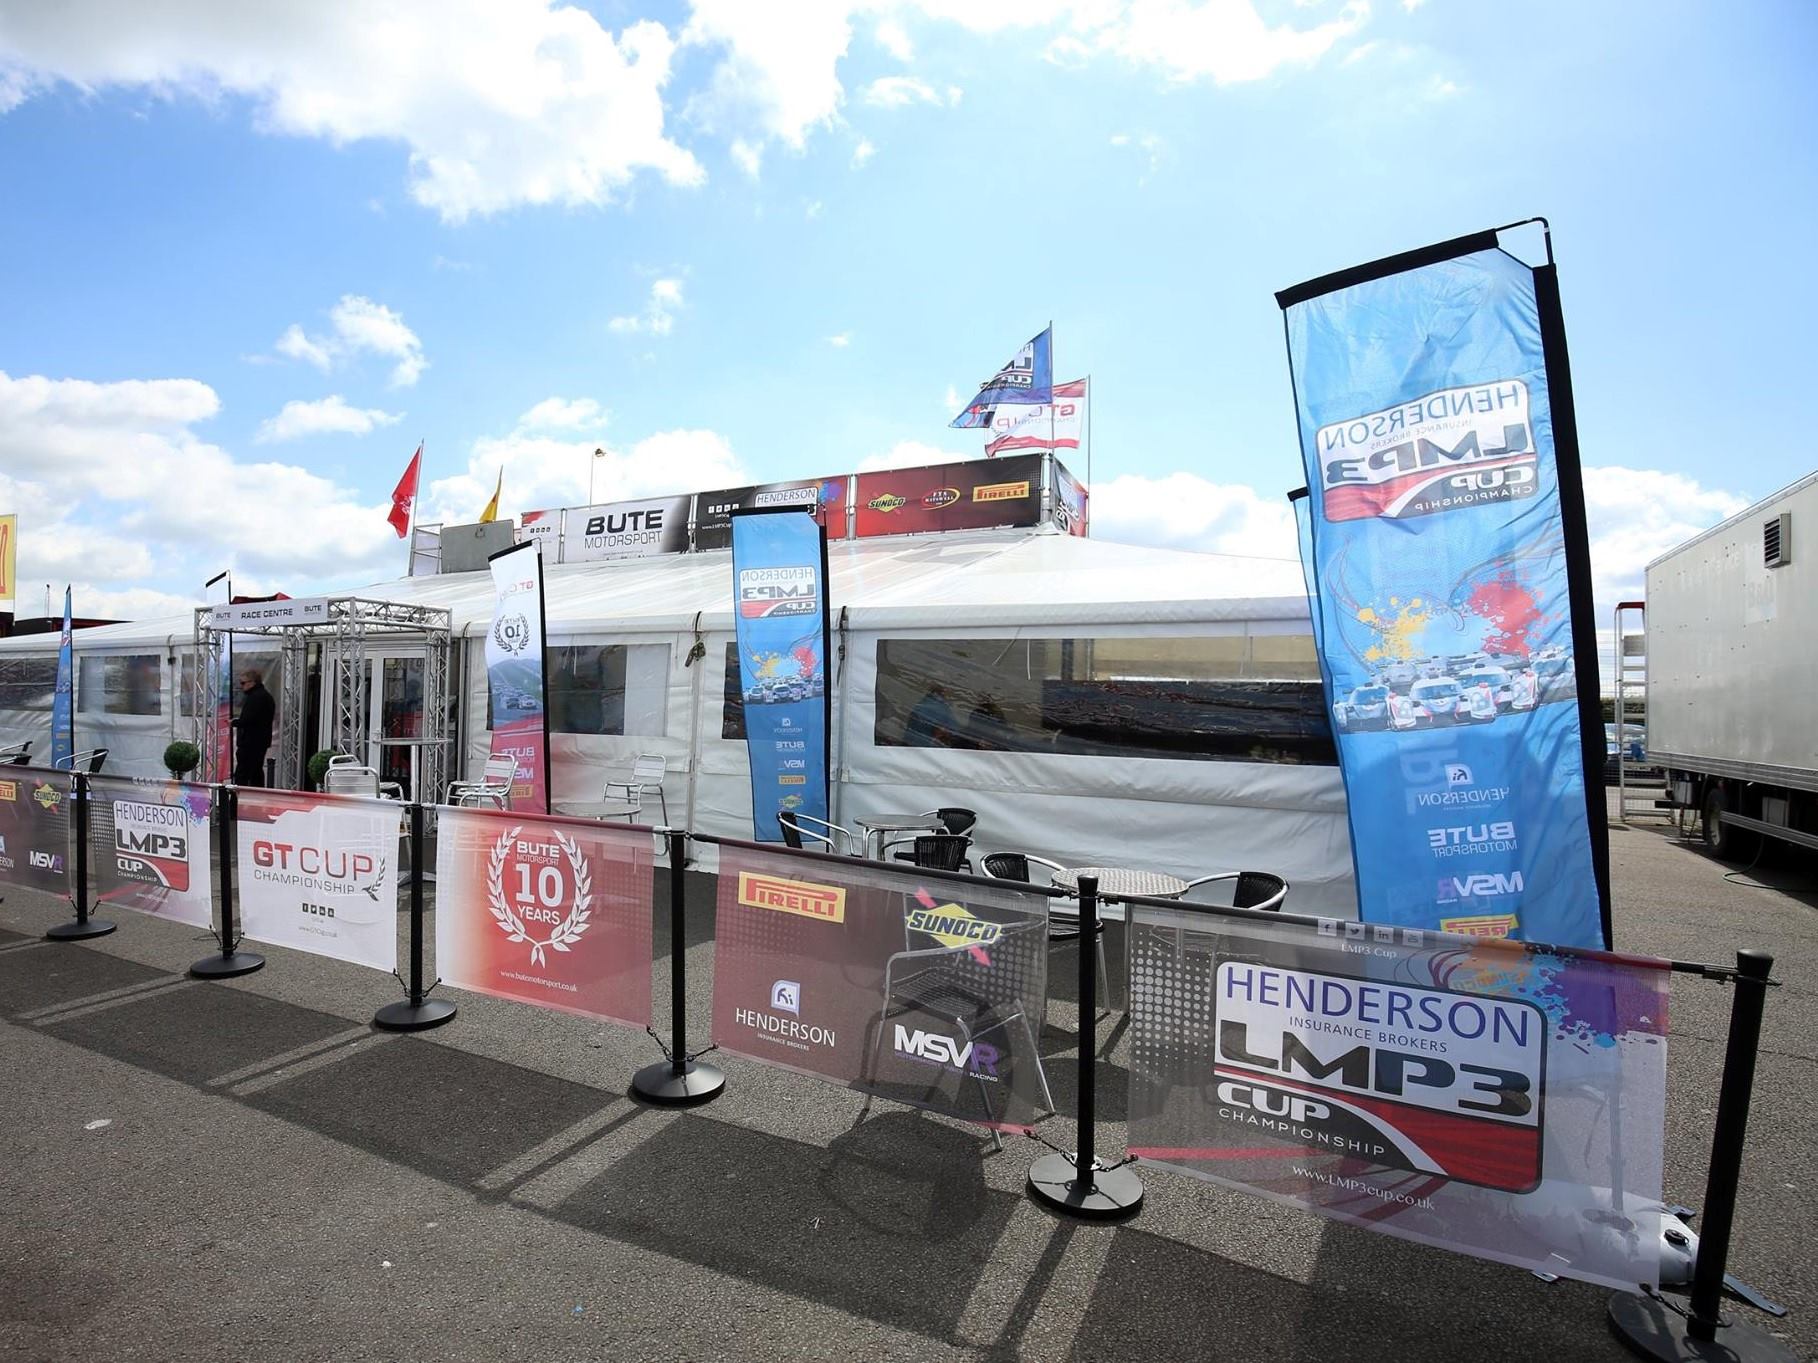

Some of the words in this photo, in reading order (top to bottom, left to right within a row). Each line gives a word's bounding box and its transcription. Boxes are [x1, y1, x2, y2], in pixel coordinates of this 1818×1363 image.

[757, 489, 816, 504] HENDERSON
[869, 498, 905, 508] SUNOCO
[977, 484, 1026, 499] PIRELLI
[585, 509, 664, 536] BUTE
[584, 530, 663, 549] MOTORSPORT
[241, 610, 261, 619] RACE
[263, 608, 293, 618] CENTRE
[304, 604, 322, 612] BUTE
[35, 790, 60, 803] SUNOCO
[115, 803, 184, 827] HENDERSON
[116, 828, 187, 858] LMP3
[516, 840, 560, 858] BUTE
[117, 858, 142, 872] CUP
[253, 840, 293, 870] GT
[299, 846, 373, 881] CUP
[516, 853, 559, 866] MOTORSPORT
[117, 870, 157, 882] CHAMPIONSHIP
[254, 869, 355, 895] CHAMPIONSHIP
[515, 863, 564, 907] 10
[745, 877, 838, 917] PIRELLI
[517, 904, 561, 925] YEARS
[908, 912, 999, 941] SUNOCO
[1341, 943, 1371, 955] LMP3
[1374, 947, 1398, 959] Cup
[500, 970, 578, 993] www.butemotorsport.co.uk
[1226, 966, 1528, 1048] HENDERSON
[735, 1007, 836, 1047] HENDERSON
[1289, 1015, 1372, 1041] INSURANCE
[1378, 1031, 1448, 1053] BROKERS
[757, 1032, 785, 1046] INSURANCE
[786, 1039, 810, 1051] BROKERS
[894, 1023, 999, 1075] MSVR
[969, 1071, 998, 1082] RACING
[1219, 1019, 1533, 1117] LMP3
[1217, 1081, 1331, 1122] CUP
[1218, 1108, 1386, 1156] CHAMPIONSHIP
[1292, 1165, 1435, 1211] www.LMP3cup.co.uk
